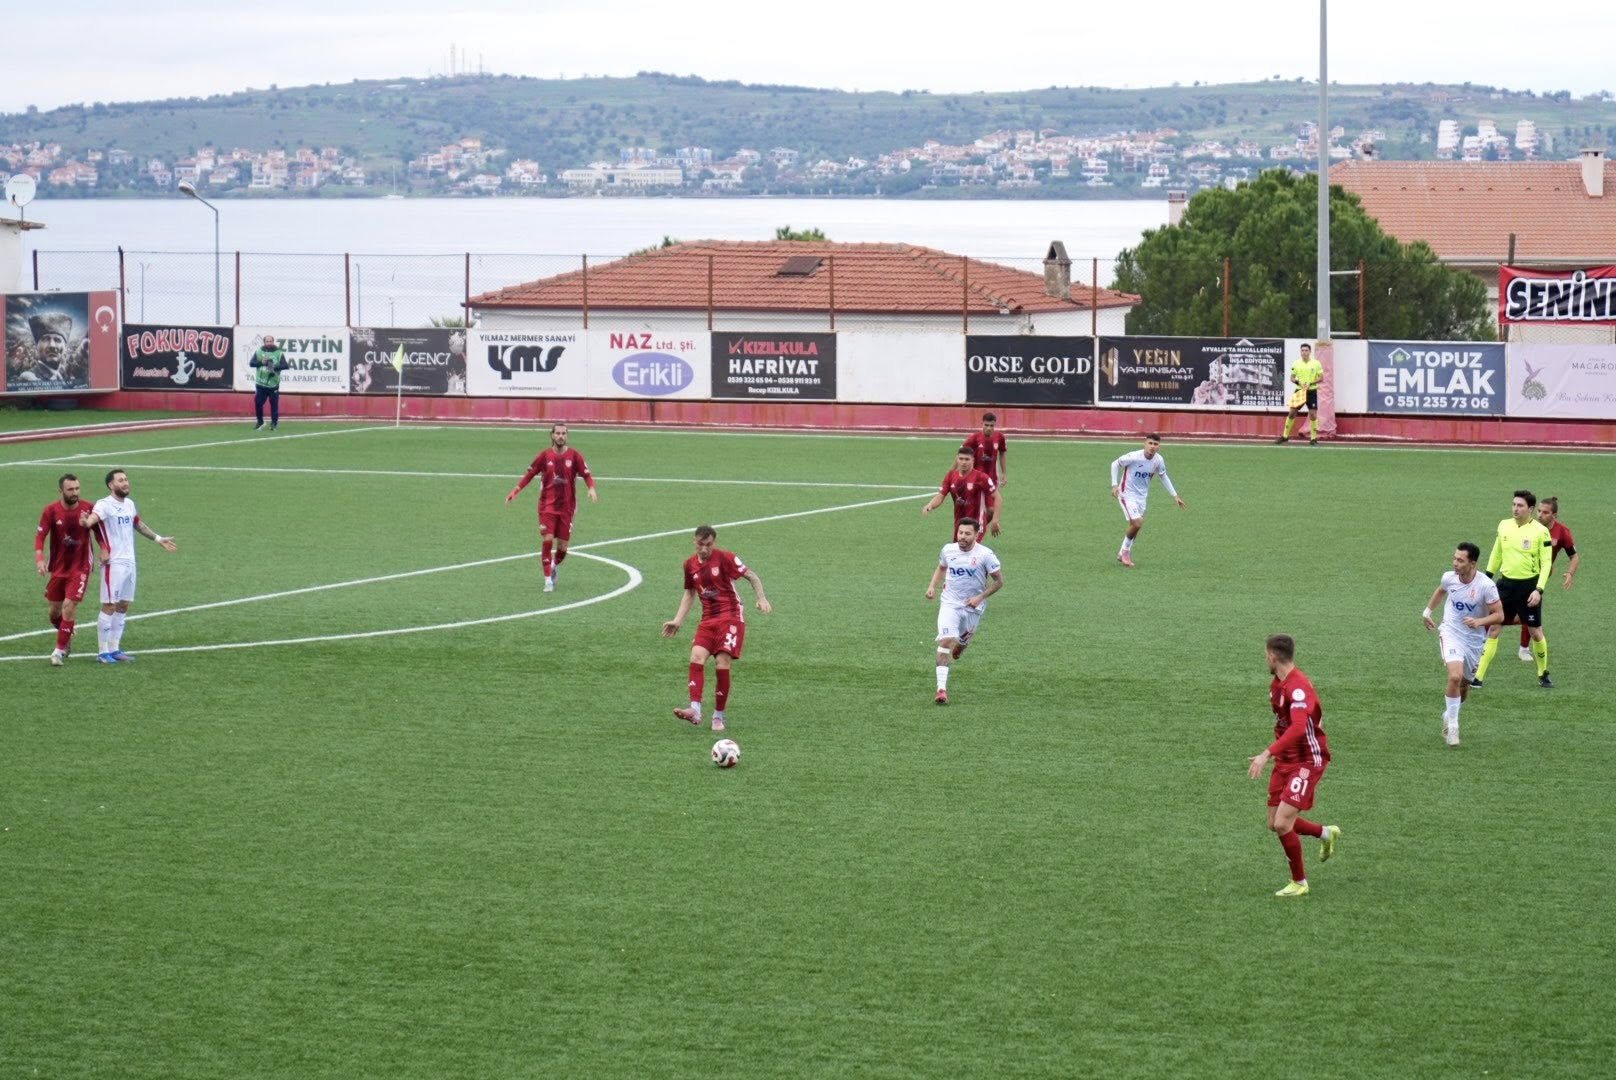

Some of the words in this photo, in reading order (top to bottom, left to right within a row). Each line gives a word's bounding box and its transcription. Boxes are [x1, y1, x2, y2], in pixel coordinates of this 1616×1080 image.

[127, 329, 229, 358] FOKURTU
[277, 335, 343, 353] ZEYTİN
[480, 334, 509, 342] YILMAZ
[544, 334, 576, 343] SANAYİ
[610, 333, 652, 349] NAZ
[656, 341, 676, 350] Ltd.
[680, 340, 696, 351] Şti.
[743, 341, 818, 355] KIZILKULA
[728, 356, 819, 375] HAFRİYAT
[968, 355, 1024, 373] ORSE
[1030, 356, 1091, 374] GOLD
[1412, 351, 1483, 368] TOPUZ
[1571, 362, 1616, 370] MACARO
[623, 362, 682, 386] Erikli
[1119, 366, 1148, 374] YAPI
[293, 375, 318, 383] APART
[320, 375, 342, 383] OTEL
[1378, 367, 1496, 395] EMLAK
[1384, 396, 1394, 407] 0
[1397, 396, 1420, 407] 551
[1422, 397, 1448, 408] 235
[1451, 397, 1467, 408] 73
[1470, 398, 1489, 409] 06
[77, 581, 85, 593] 2
[724, 633, 738, 648] 34
[1290, 776, 1308, 796] 61
